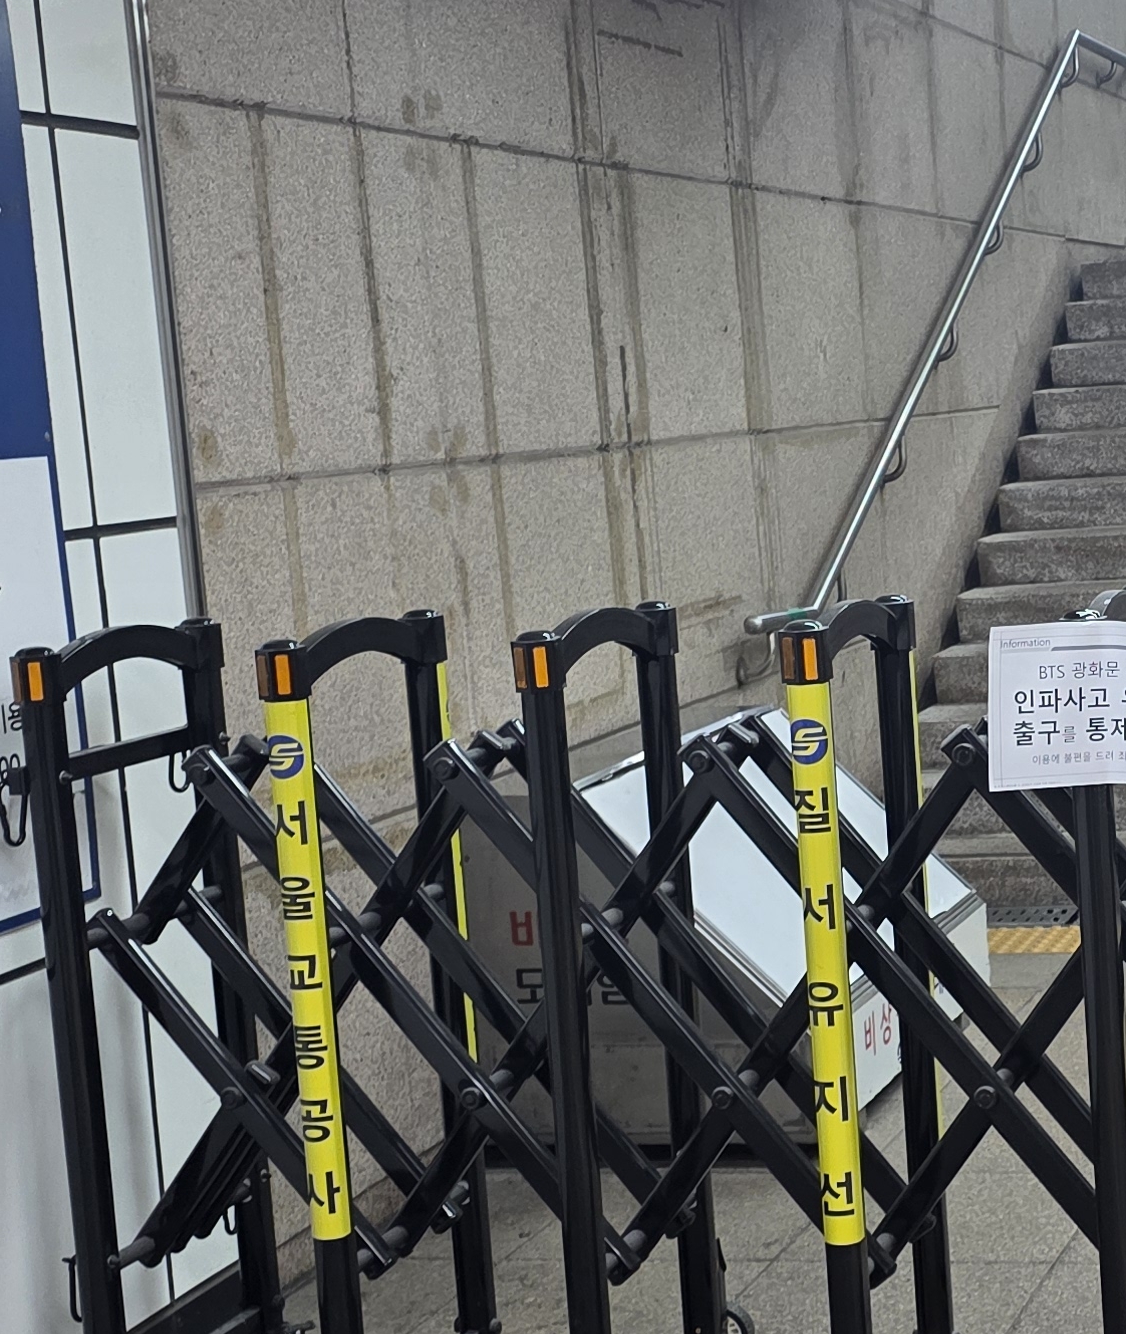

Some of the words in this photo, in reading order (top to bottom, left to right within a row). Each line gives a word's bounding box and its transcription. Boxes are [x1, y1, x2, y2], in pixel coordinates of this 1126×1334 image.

[1000, 638, 1051, 649] Information
[1038, 665, 1065, 680] BTS
[1071, 661, 1121, 679] 광화문
[1014, 686, 1110, 715] 인파사고
[1013, 720, 1077, 747] 출구를
[1032, 753, 1060, 765] 이용에
[1064, 751, 1091, 764] 불편을
[274, 799, 342, 1215] 서울교통공사
[794, 787, 856, 1219] 질서유지선
